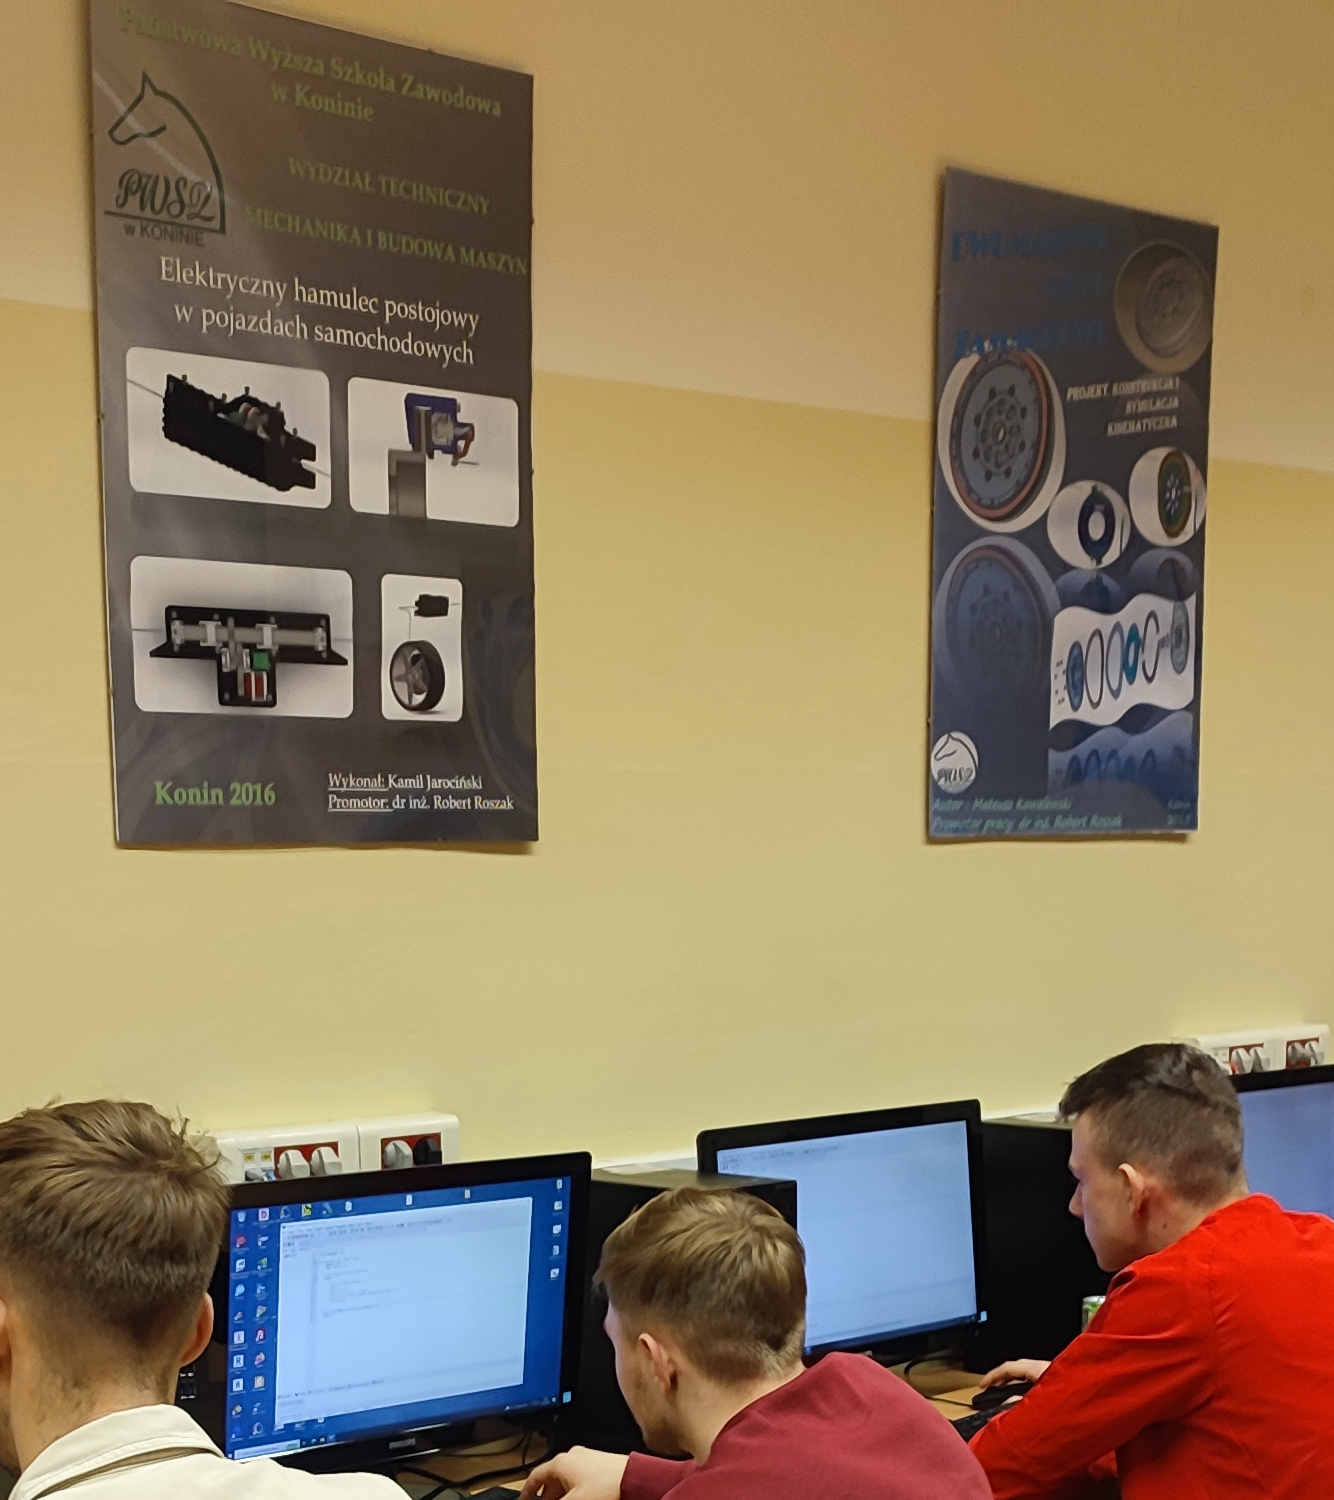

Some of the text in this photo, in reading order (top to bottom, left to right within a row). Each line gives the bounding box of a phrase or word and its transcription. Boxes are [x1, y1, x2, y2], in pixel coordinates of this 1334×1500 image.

[271, 84, 374, 122] w Koninie
[330, 56, 396, 94] Szkoła
[400, 73, 502, 118] Zawodowa
[287, 156, 490, 216] WYDZIAŁ TECHNICZNY
[140, 221, 205, 248] KONINIE
[245, 205, 528, 276] MECHANIKA I BUDOWA MASZYN
[159, 255, 480, 338] Elektryczny hamulec postojowy
[174, 303, 475, 369] w pojazdach samochodowych
[154, 780, 276, 807] Konin 2016
[328, 773, 483, 792] Wykonał: Kamil Jarociński
[392, 794, 407, 810] dr
[434, 795, 473, 811] Robert
[475, 795, 515, 811] Roszak
